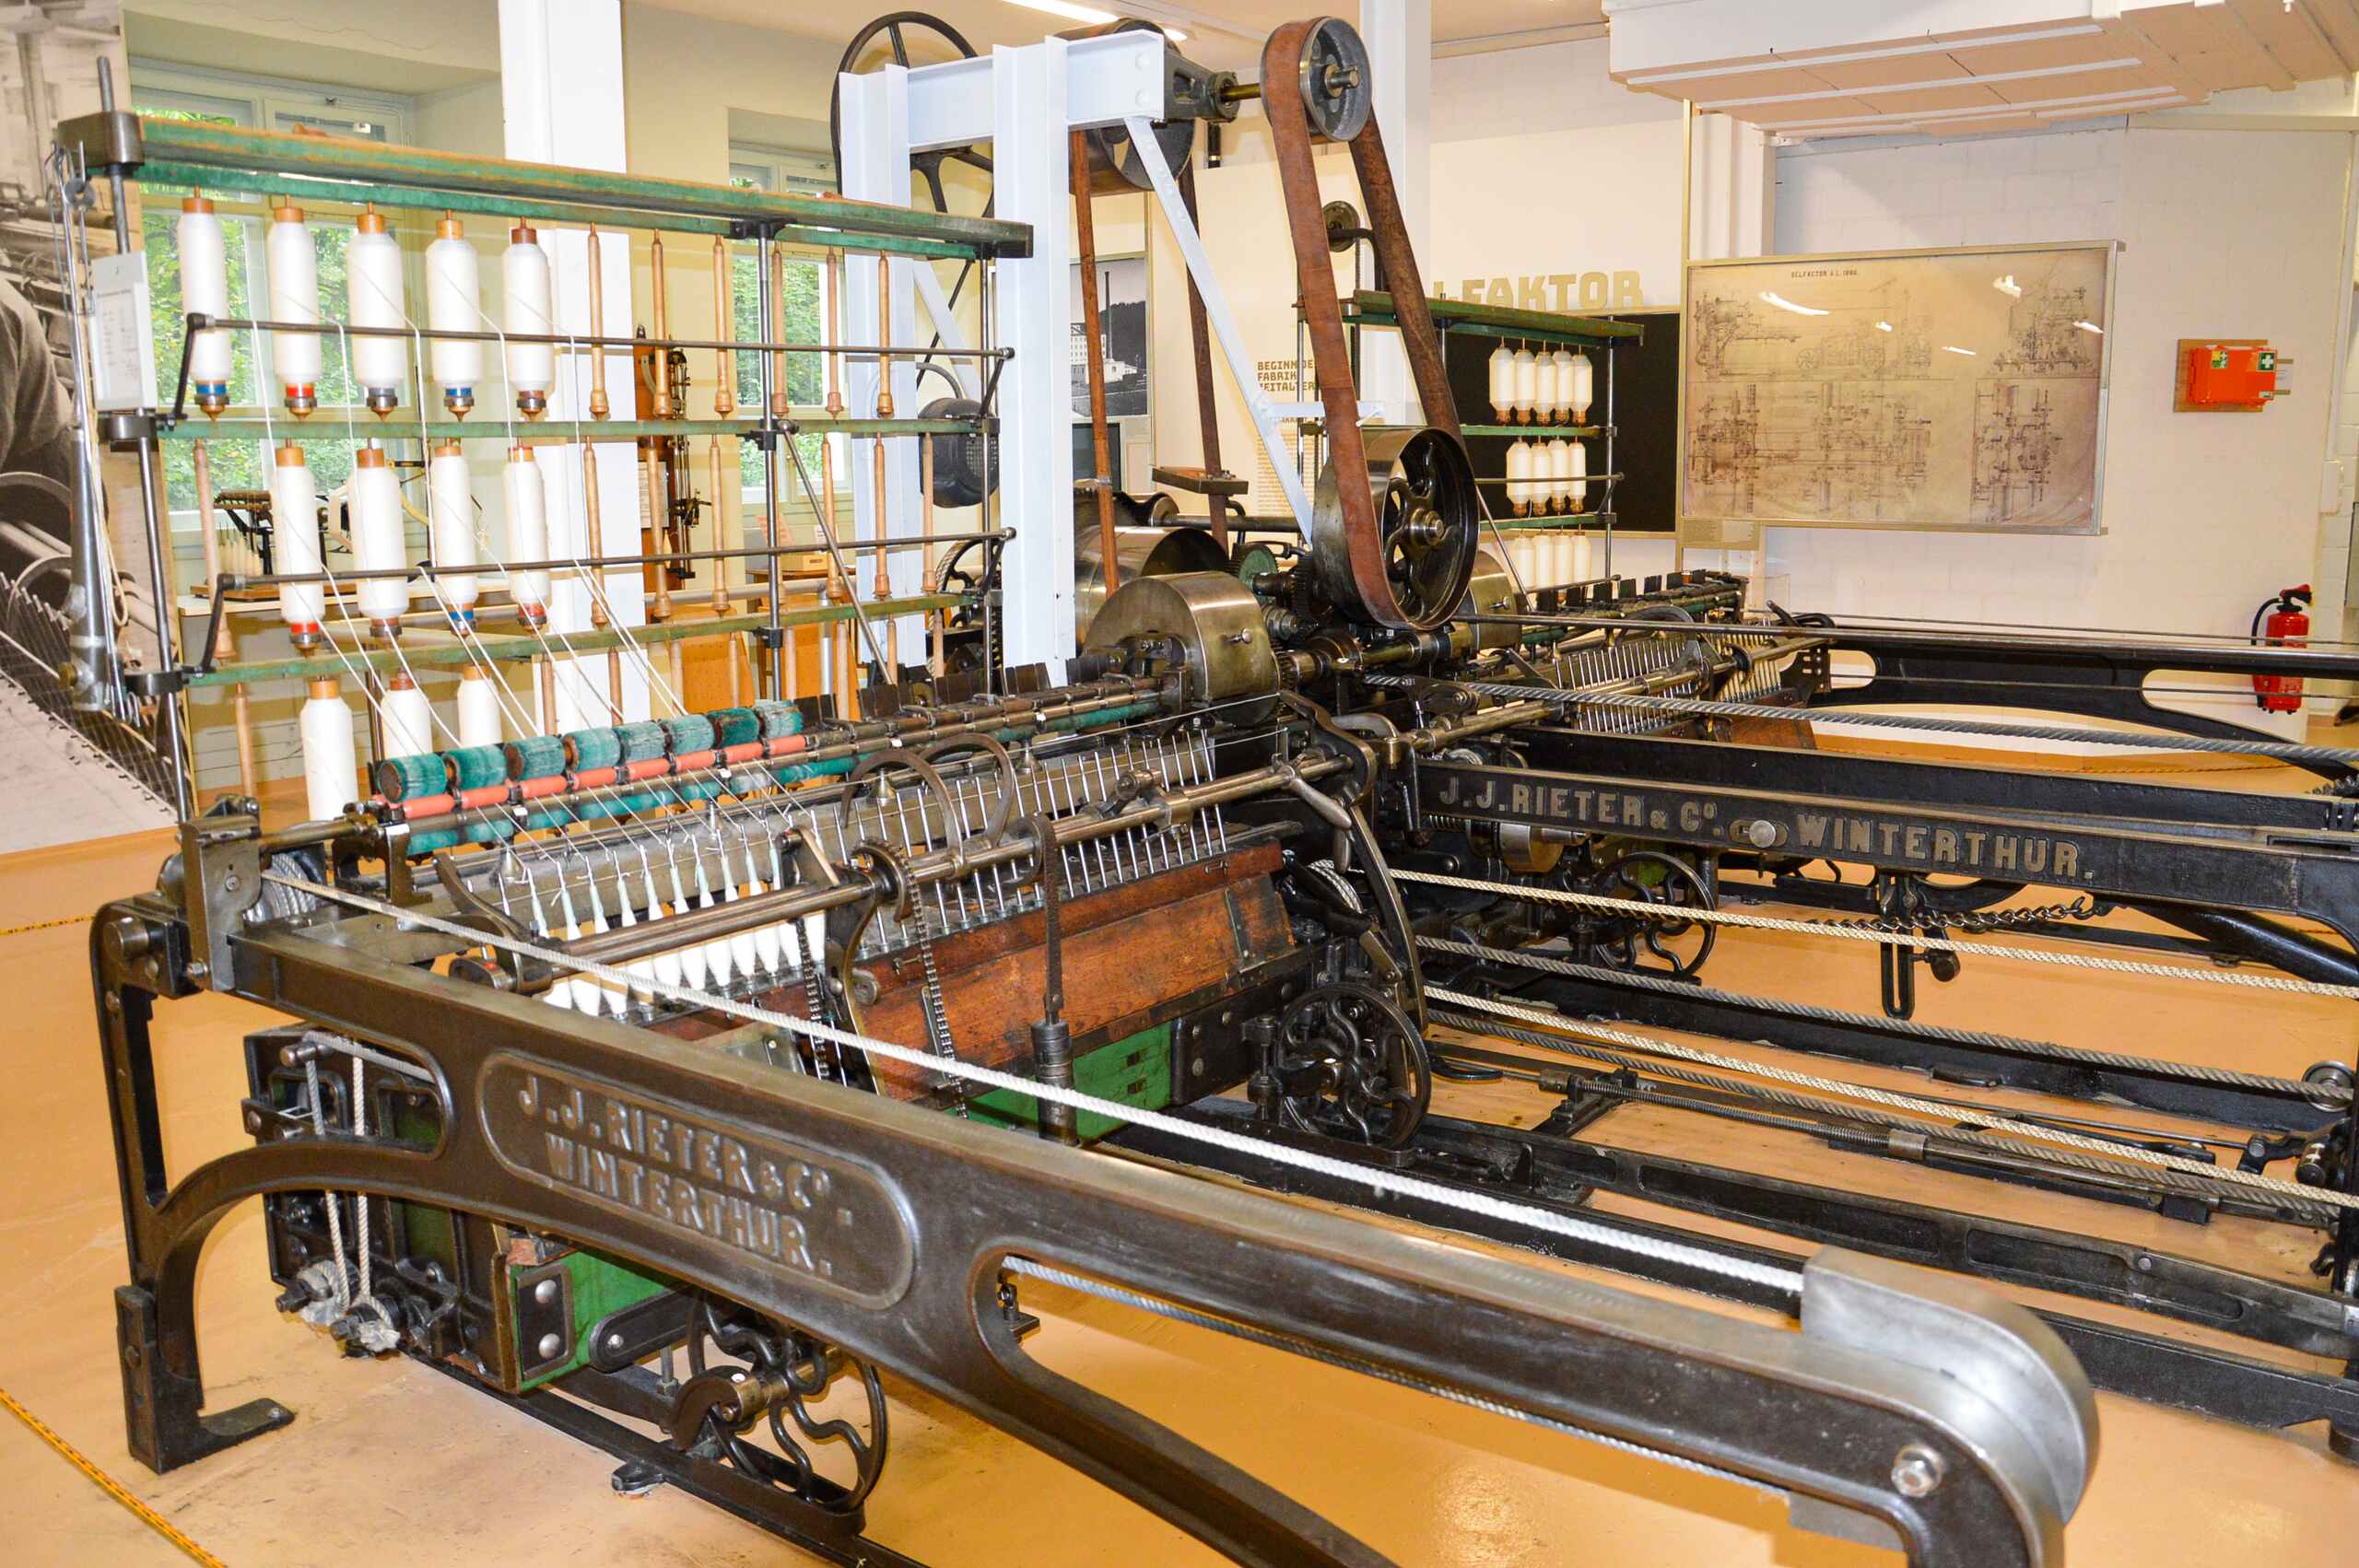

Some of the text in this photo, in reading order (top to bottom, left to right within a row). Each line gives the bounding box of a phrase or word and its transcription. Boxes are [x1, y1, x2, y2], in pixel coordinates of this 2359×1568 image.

[1257, 371, 1297, 381] FABRIK
[1797, 813, 2095, 880] WINTERTHUR.
[545, 1131, 833, 1277] WINTERTHUR.
